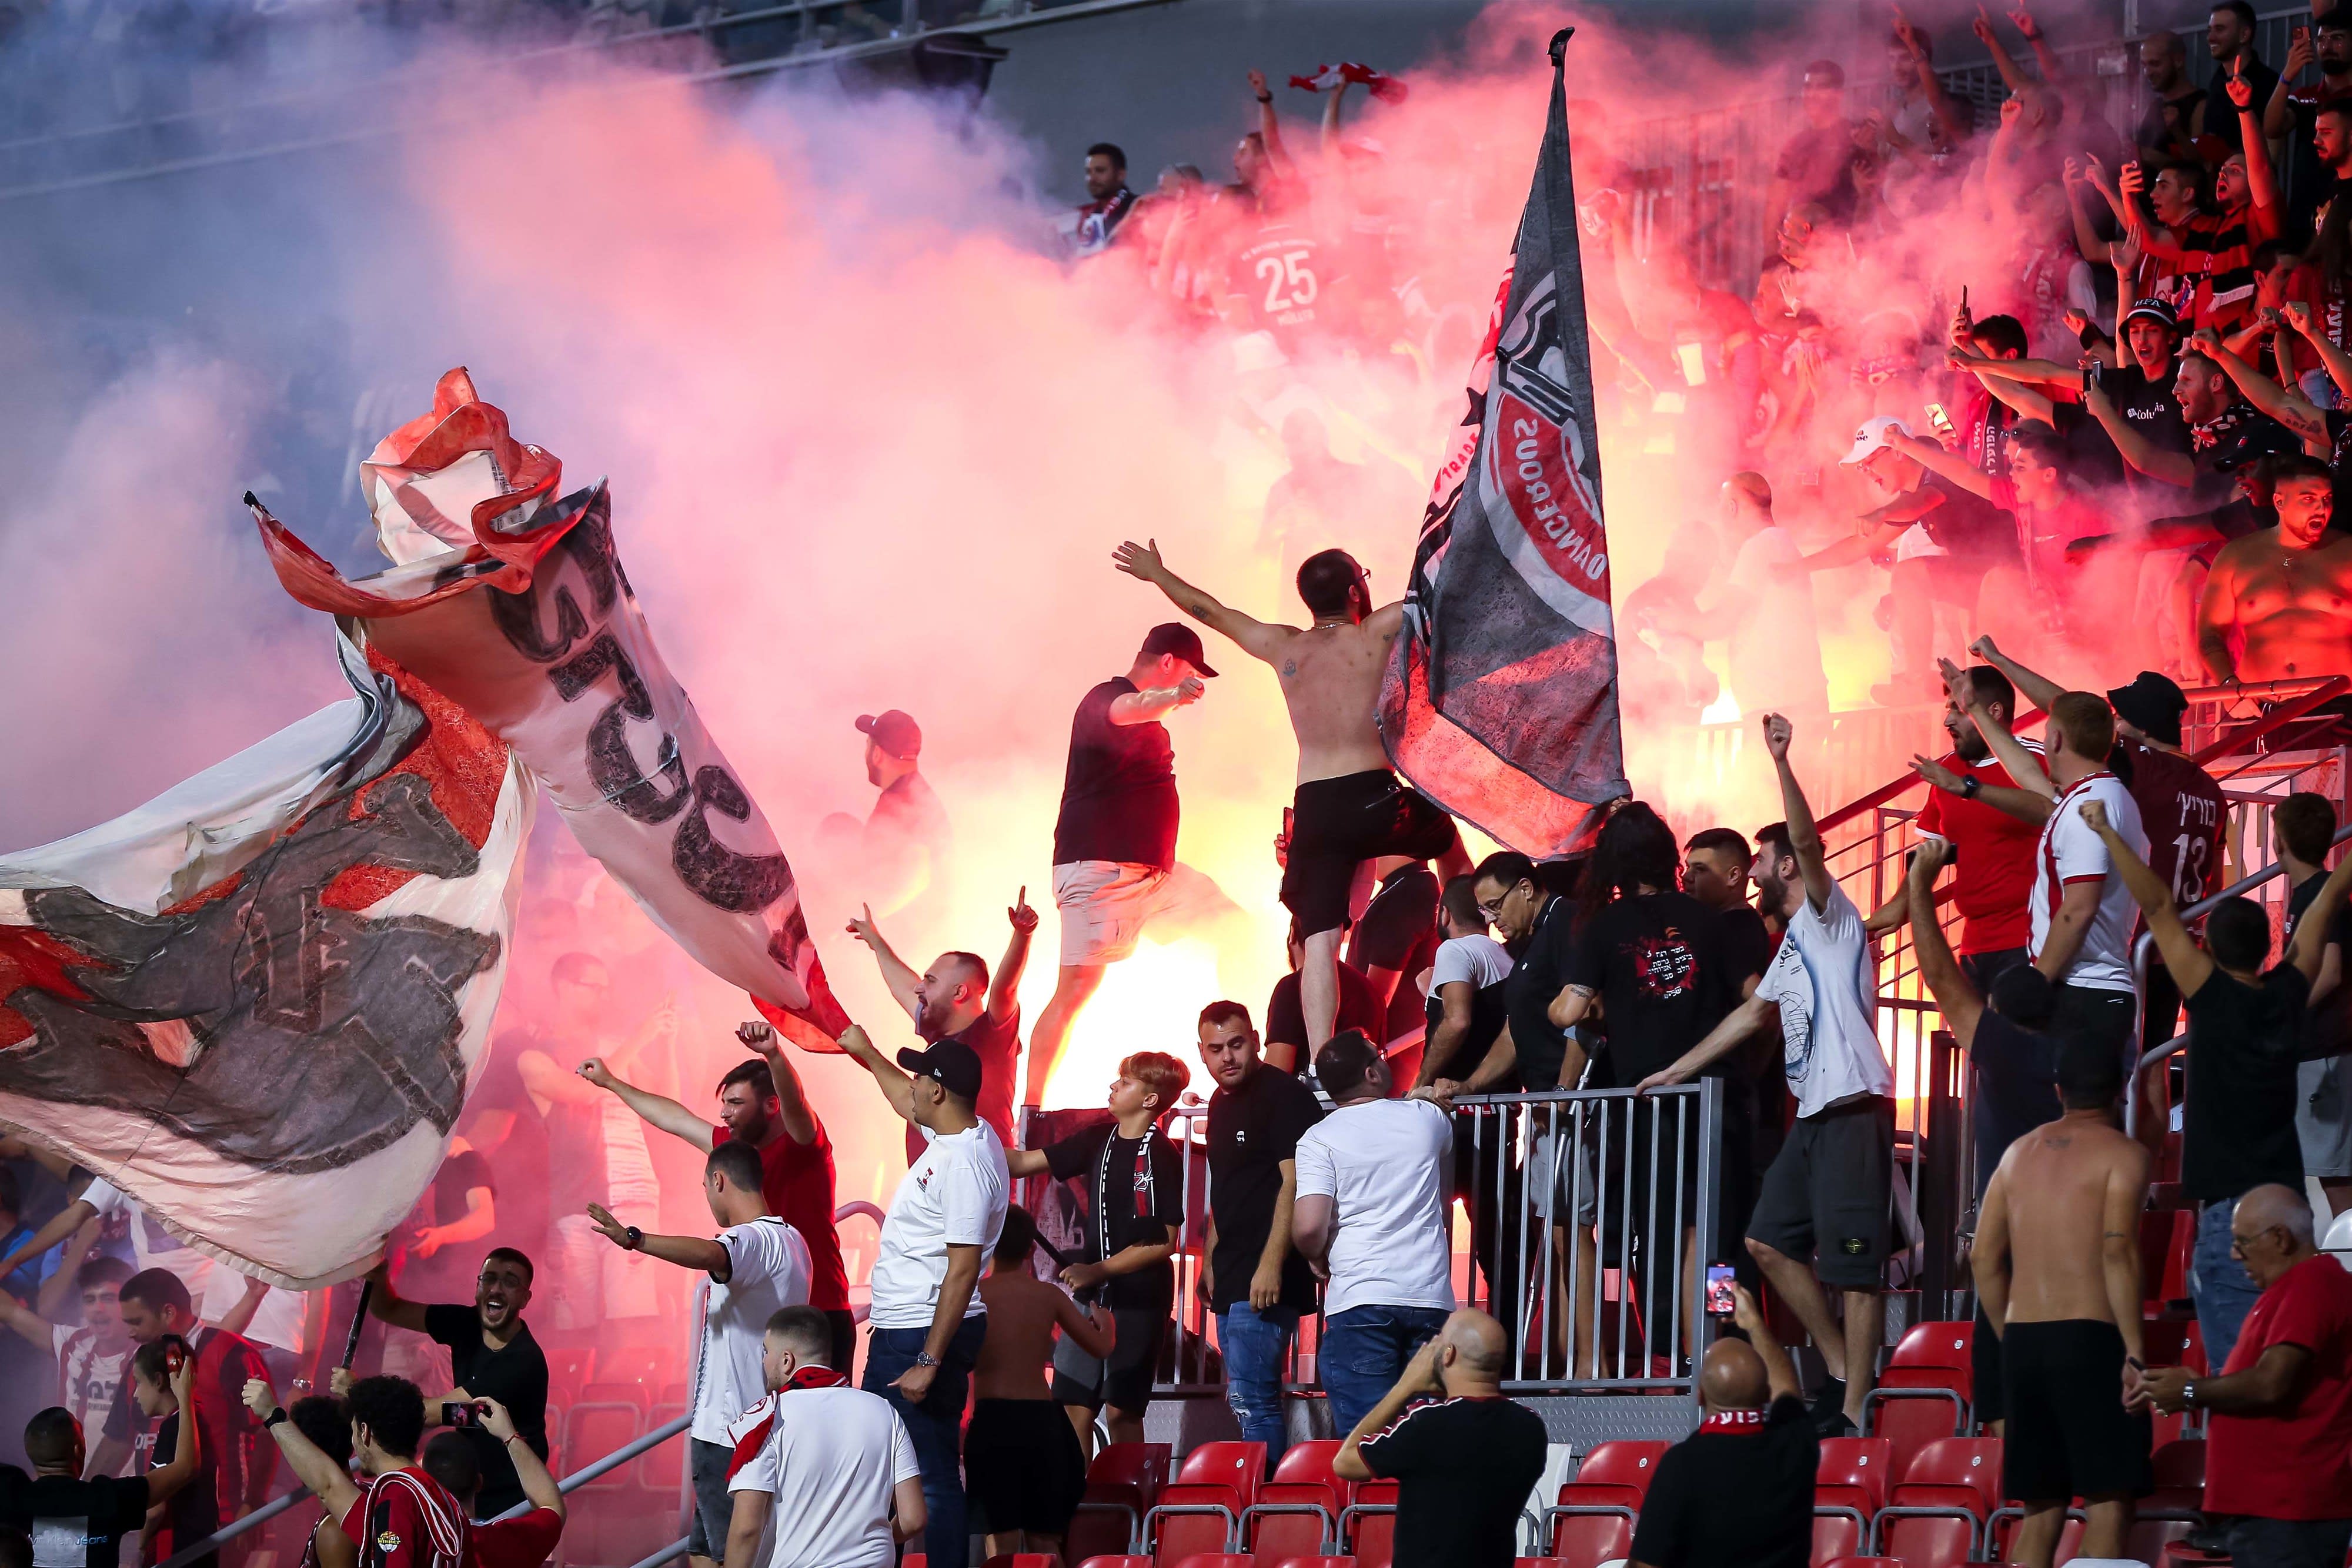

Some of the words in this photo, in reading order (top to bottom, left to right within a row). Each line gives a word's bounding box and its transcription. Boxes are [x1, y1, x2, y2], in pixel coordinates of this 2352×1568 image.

[1255, 250, 1318, 313] 25
[2137, 402, 2164, 420] Coluia
[1986, 426, 1996, 466] הפועל
[2172, 834, 2206, 904] 13
[1671, 945, 1685, 954] בשר
[1675, 954, 1693, 964] ביצים
[1676, 965, 1690, 974] חלב
[75, 1534, 108, 1546] Jeans
